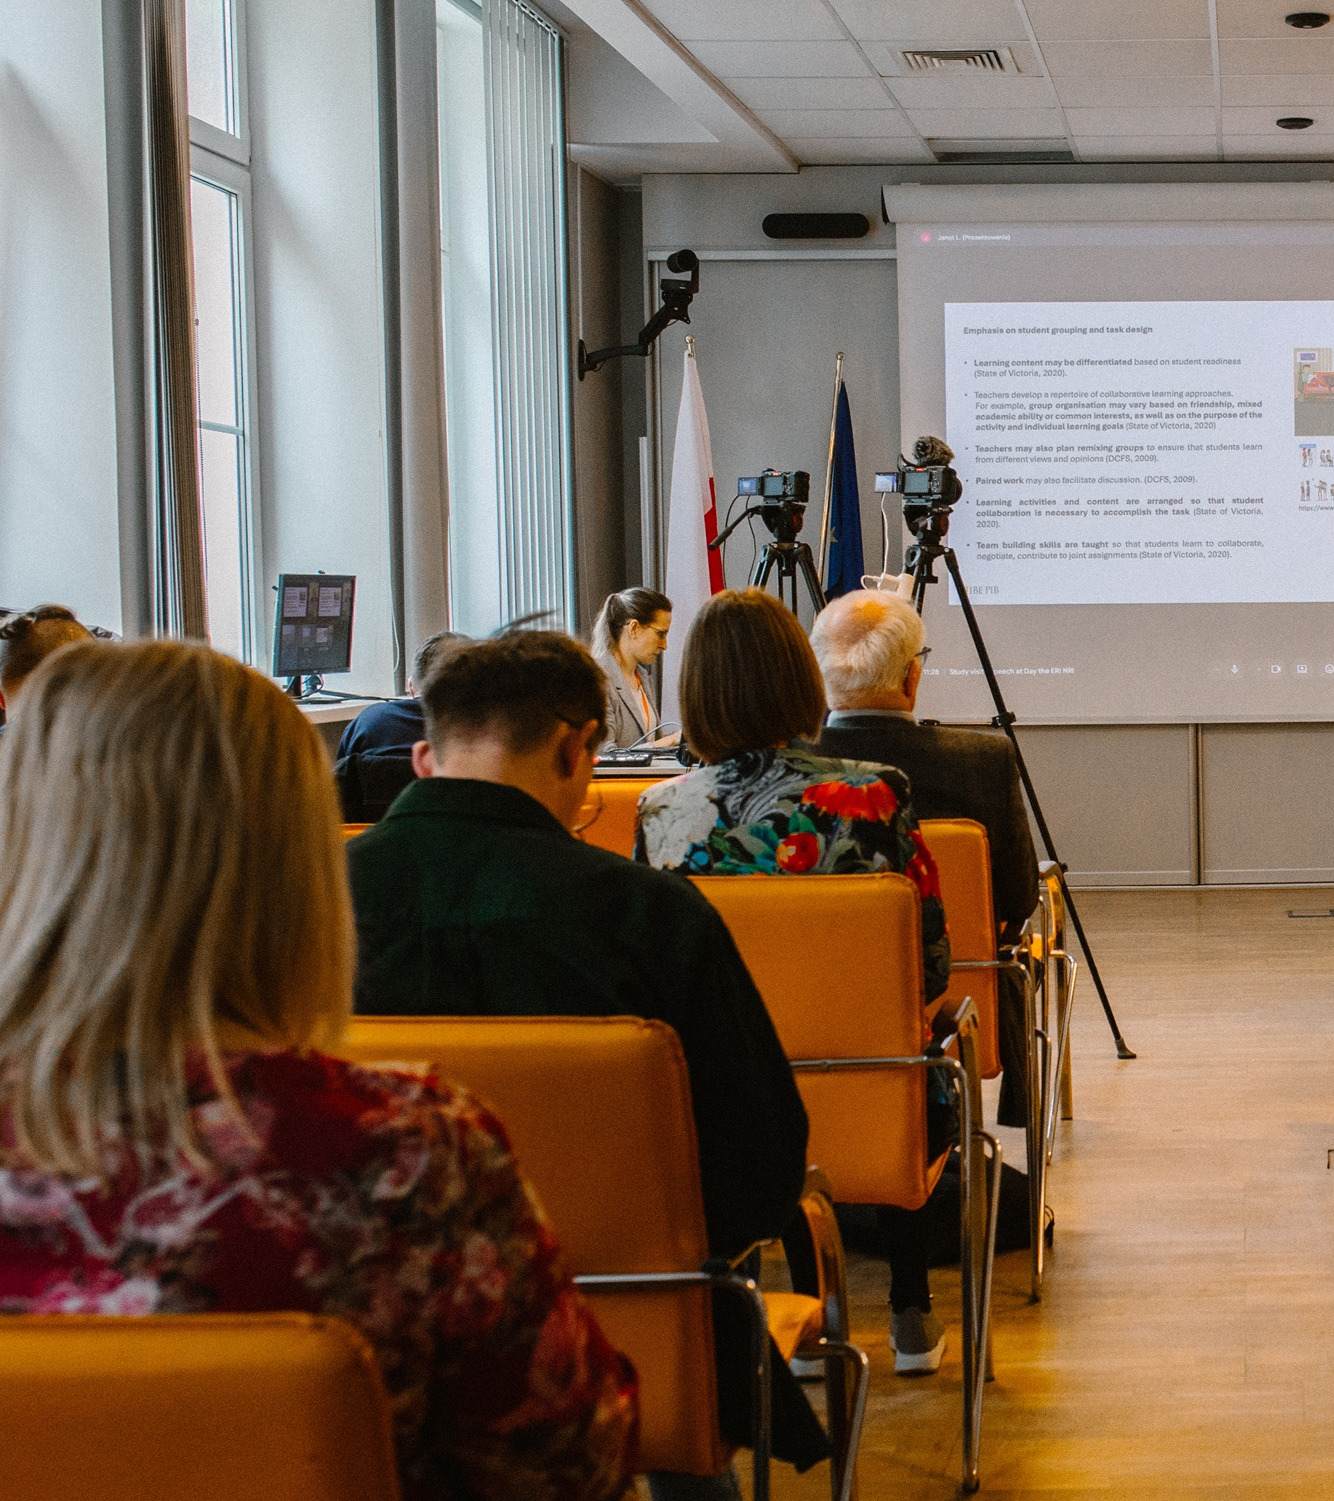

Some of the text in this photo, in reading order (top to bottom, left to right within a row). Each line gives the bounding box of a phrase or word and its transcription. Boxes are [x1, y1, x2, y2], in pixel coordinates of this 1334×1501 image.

[964, 325, 1153, 336] Emphasis on student grouping and task design
[974, 358, 1010, 369] Learning
[1011, 359, 1043, 367] content
[1045, 359, 1063, 368] may
[1064, 358, 1075, 367] be
[1076, 358, 1132, 367] differentiated
[1134, 358, 1158, 366] based
[1172, 357, 1201, 366] student
[1203, 357, 1241, 366] readiness
[974, 369, 997, 379] (State
[999, 369, 1007, 378] of
[1008, 369, 1040, 378] Victoria,
[975, 390, 1009, 399] Teachers
[1011, 391, 1042, 400] develop
[1051, 391, 1088, 400] repertoire
[1090, 390, 1098, 399] of
[1100, 390, 1150, 399] collaborative
[1152, 390, 1183, 399] learning
[1185, 389, 1233, 399] approaches.
[976, 401, 988, 410] For
[991, 402, 1026, 410] example,
[1029, 402, 1053, 411] group
[1055, 401, 1106, 411] organisation
[1109, 402, 1126, 410] may
[1129, 402, 1147, 410] vary
[1149, 400, 1174, 409] based
[1190, 400, 1234, 410] friendship,
[1237, 400, 1262, 408] mixed
[975, 412, 1016, 421] academic
[1018, 412, 1043, 422] ability
[1094, 412, 1132, 421] interests,
[1146, 411, 1163, 420] well
[1165, 412, 1174, 420] as
[1176, 412, 1186, 420] on
[1188, 411, 1201, 419] the
[1203, 412, 1237, 421] purpose
[1239, 410, 1248, 419] of
[1249, 410, 1262, 419] the
[976, 423, 1006, 432] activity
[1008, 423, 1023, 431] and
[1025, 422, 1065, 431] individual
[1067, 422, 1100, 432] learning
[1102, 422, 1124, 432] goals
[1126, 421, 1148, 431] (State
[1150, 422, 1158, 430] of
[1160, 421, 1192, 430] Victoria,
[975, 442, 1263, 454] Teachers may also plan remixing groups to ensure that students learn
[975, 455, 994, 464] from
[996, 455, 1028, 464] different
[1030, 455, 1052, 463] views
[1054, 455, 1068, 463] and
[1070, 455, 1104, 464] opinions
[976, 476, 1002, 485] Paired
[1003, 476, 1024, 485] work
[1026, 477, 1042, 486] may
[1044, 476, 1061, 485] also
[1062, 476, 1096, 484] facilitate
[1098, 475, 1142, 484] discussion.
[976, 498, 1012, 508] Learning
[1019, 498, 1056, 507] activities
[1064, 497, 1079, 506] and
[1087, 498, 1119, 506] content
[1126, 498, 1139, 506] are
[1147, 496, 1183, 507] arranged
[1208, 496, 1224, 505] that
[1232, 496, 1264, 505] student
[976, 507, 1263, 518] collaboration is necessary to accomplish the task (State of Victoria,
[977, 541, 999, 550] Team
[1002, 541, 1036, 551] building
[1039, 540, 1061, 549] skills
[1065, 541, 1078, 549] are
[1082, 540, 1108, 550] taught
[1125, 540, 1140, 548] that
[1145, 540, 1178, 548] students
[1182, 539, 1202, 548] learn
[1206, 540, 1214, 548] to
[1218, 539, 1264, 548] collaborate,
[977, 552, 1015, 562] negotiate,
[1017, 552, 1057, 560] contribute
[1059, 552, 1067, 560] to
[1069, 551, 1086, 561] joint
[1088, 551, 1137, 561] assignments
[1139, 550, 1162, 560] (State
[1164, 550, 1172, 559] of
[1173, 550, 1205, 559] Victoria,
